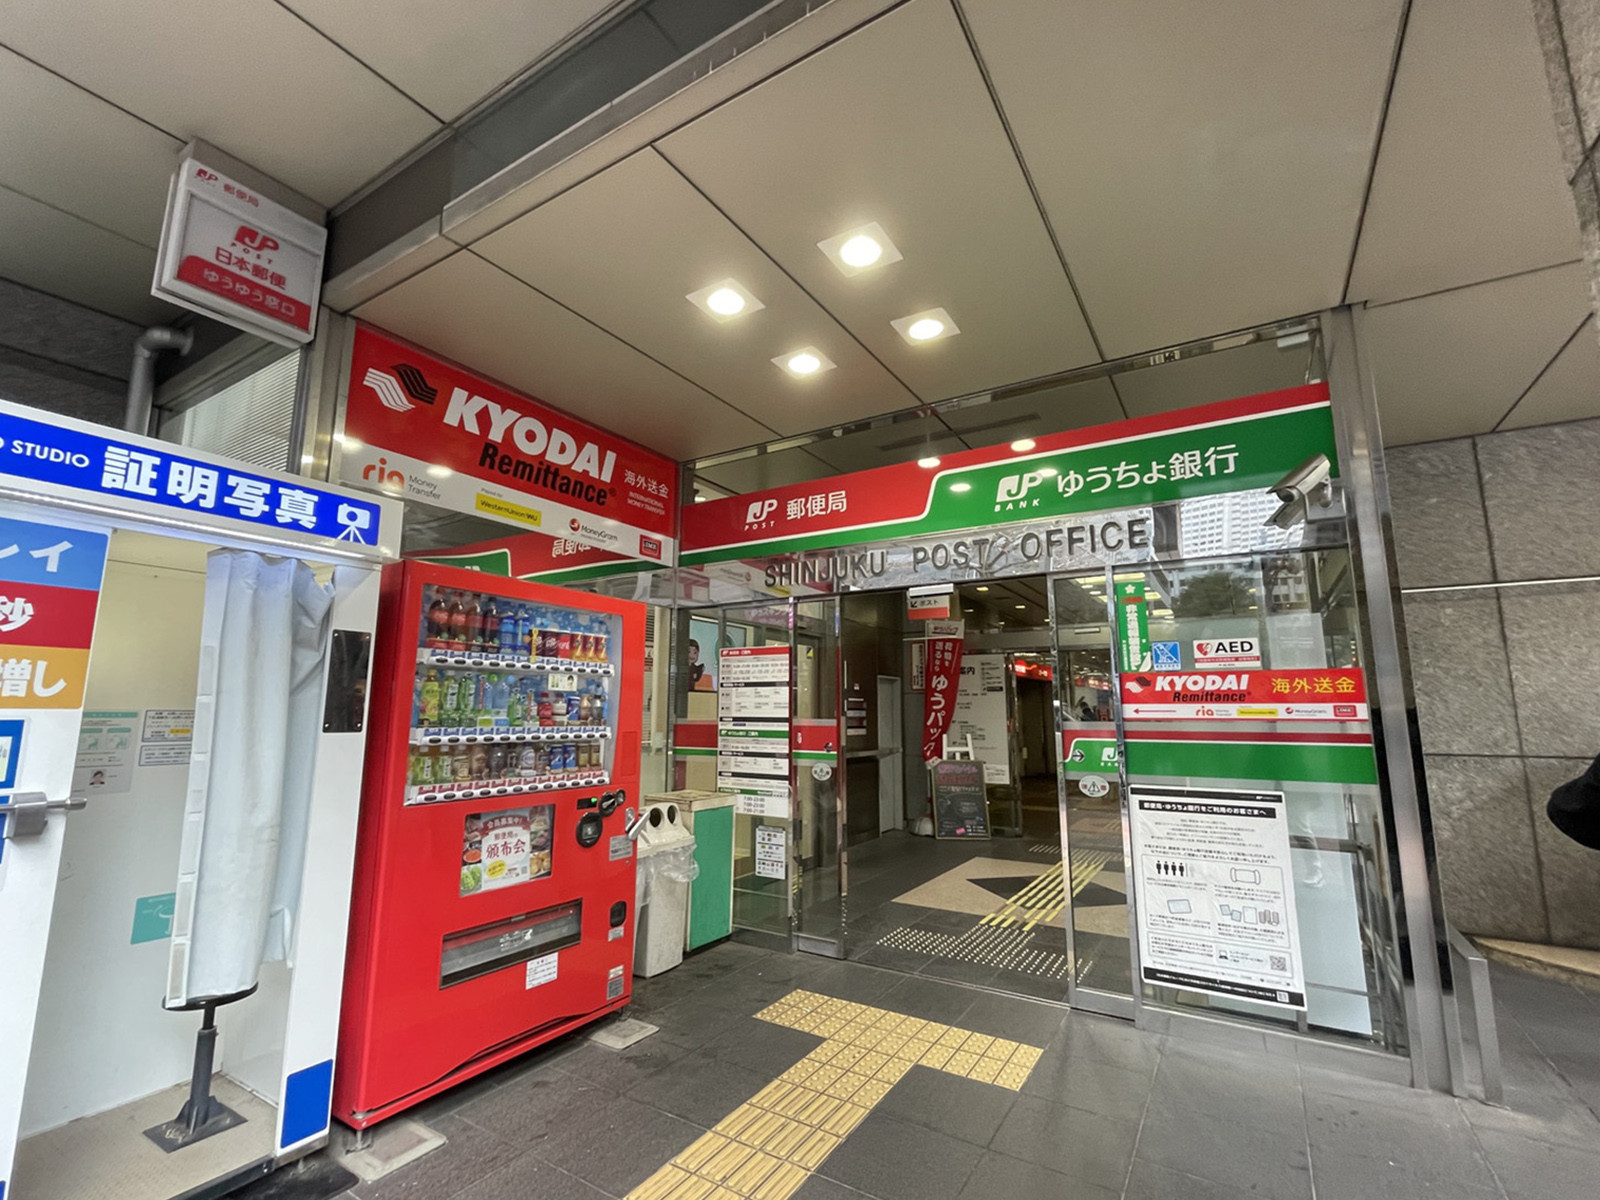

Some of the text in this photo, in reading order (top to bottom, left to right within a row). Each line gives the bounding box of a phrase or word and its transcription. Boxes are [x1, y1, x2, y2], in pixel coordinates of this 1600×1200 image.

[235, 225, 280, 252] JP
[230, 242, 273, 265] POST
[215, 246, 287, 290] 日本郵便
[203, 268, 296, 317] ゆうゆう窓口
[443, 387, 617, 483] KYODAI
[409, 474, 438, 491] Money
[478, 442, 608, 507] Remittance
[1056, 444, 1239, 498] ゆうちょ銀行
[11, 439, 319, 530] STUDIO 証明写真
[408, 483, 441, 500] Transfer
[624, 468, 669, 499] 海外送金
[745, 499, 778, 524] JP
[786, 490, 847, 521] 郵便局
[994, 498, 1040, 512] BANK
[581, 525, 618, 541] MoneyGram
[744, 520, 776, 531] POST
[764, 516, 1151, 588] SHINJUKU POST OFFICE
[1215, 641, 1254, 654] AED
[1155, 674, 1249, 692] KYODAI
[1271, 676, 1356, 694] 海外送金
[1173, 691, 1247, 703] Remittance
[923, 674, 948, 756] ゆうパック
[1195, 705, 1214, 716] ria
[486, 839, 526, 859] 頒布会
